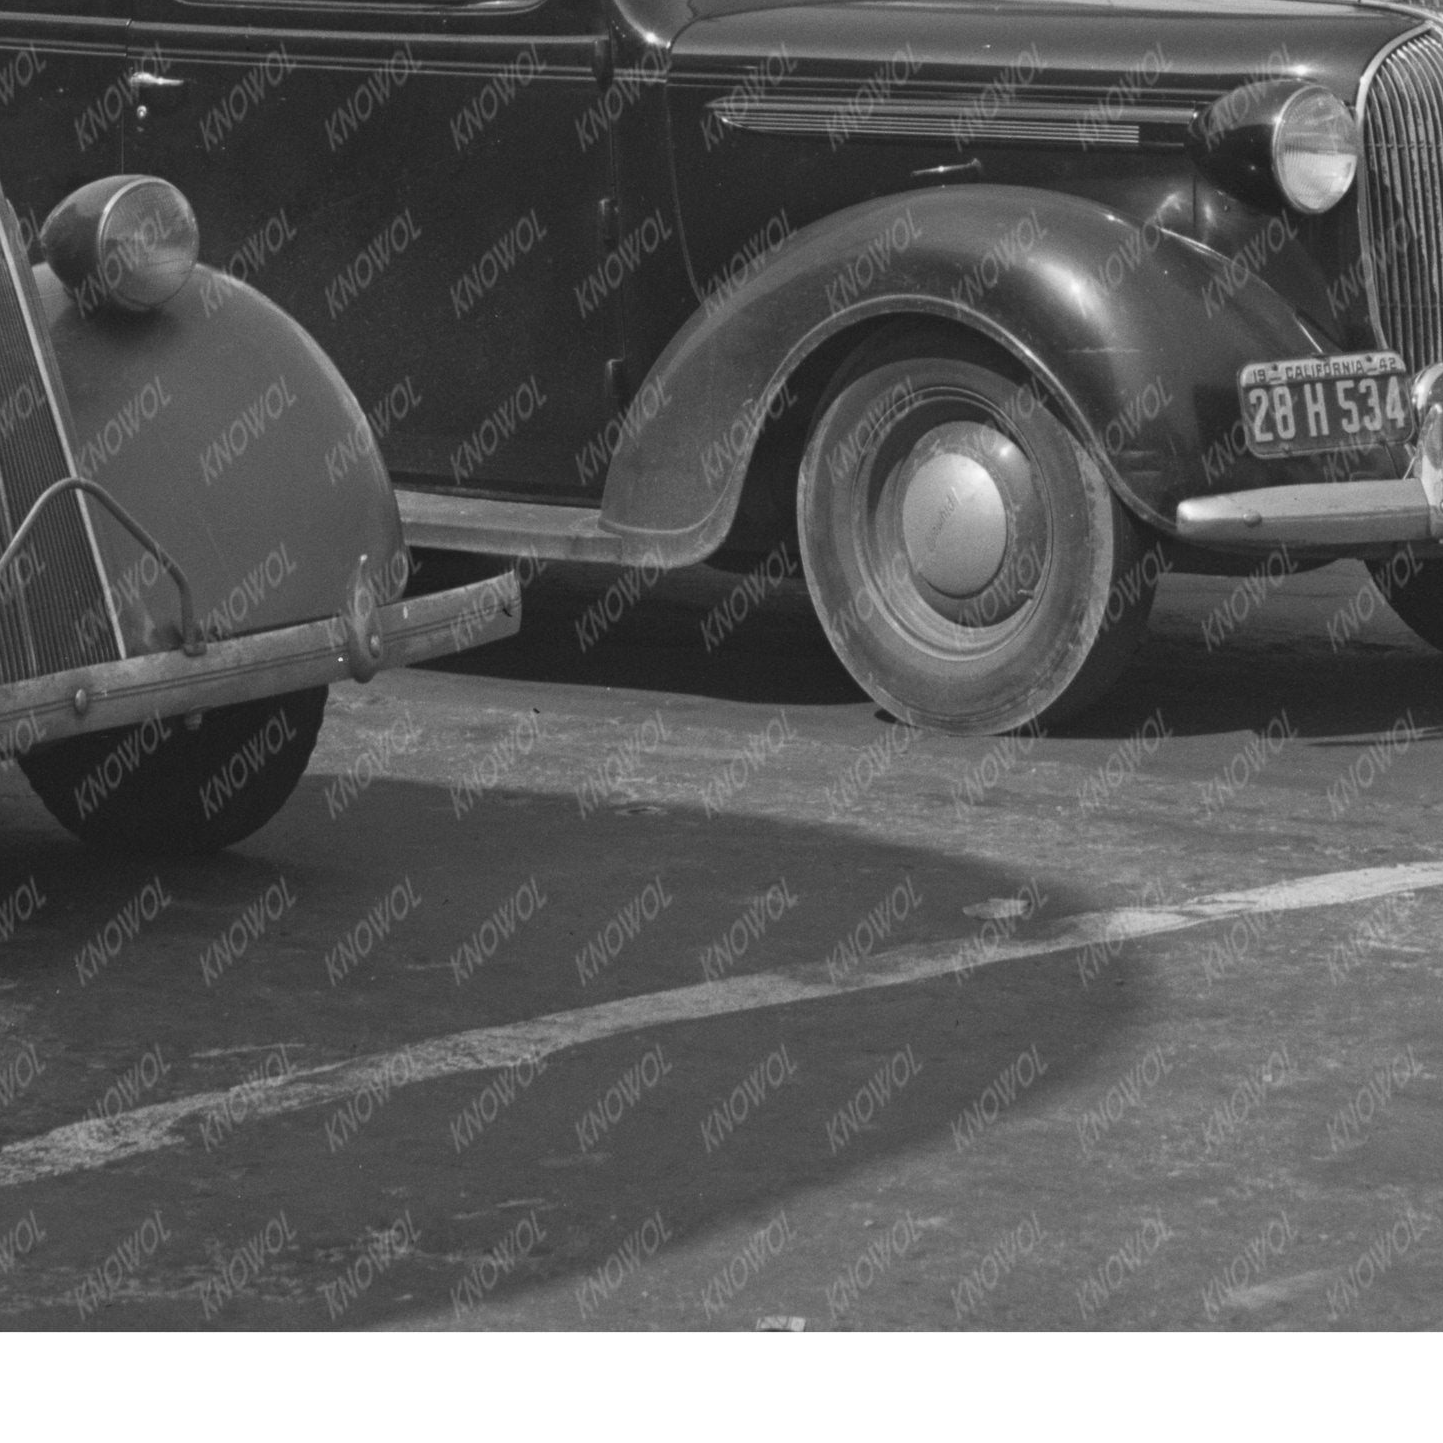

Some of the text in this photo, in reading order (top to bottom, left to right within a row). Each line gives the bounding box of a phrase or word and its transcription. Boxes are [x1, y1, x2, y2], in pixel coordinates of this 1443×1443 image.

[1285, 359, 1365, 380] CALIFORNIA
[1378, 357, 1397, 370] 42
[1249, 376, 1406, 443] 28 H 534
